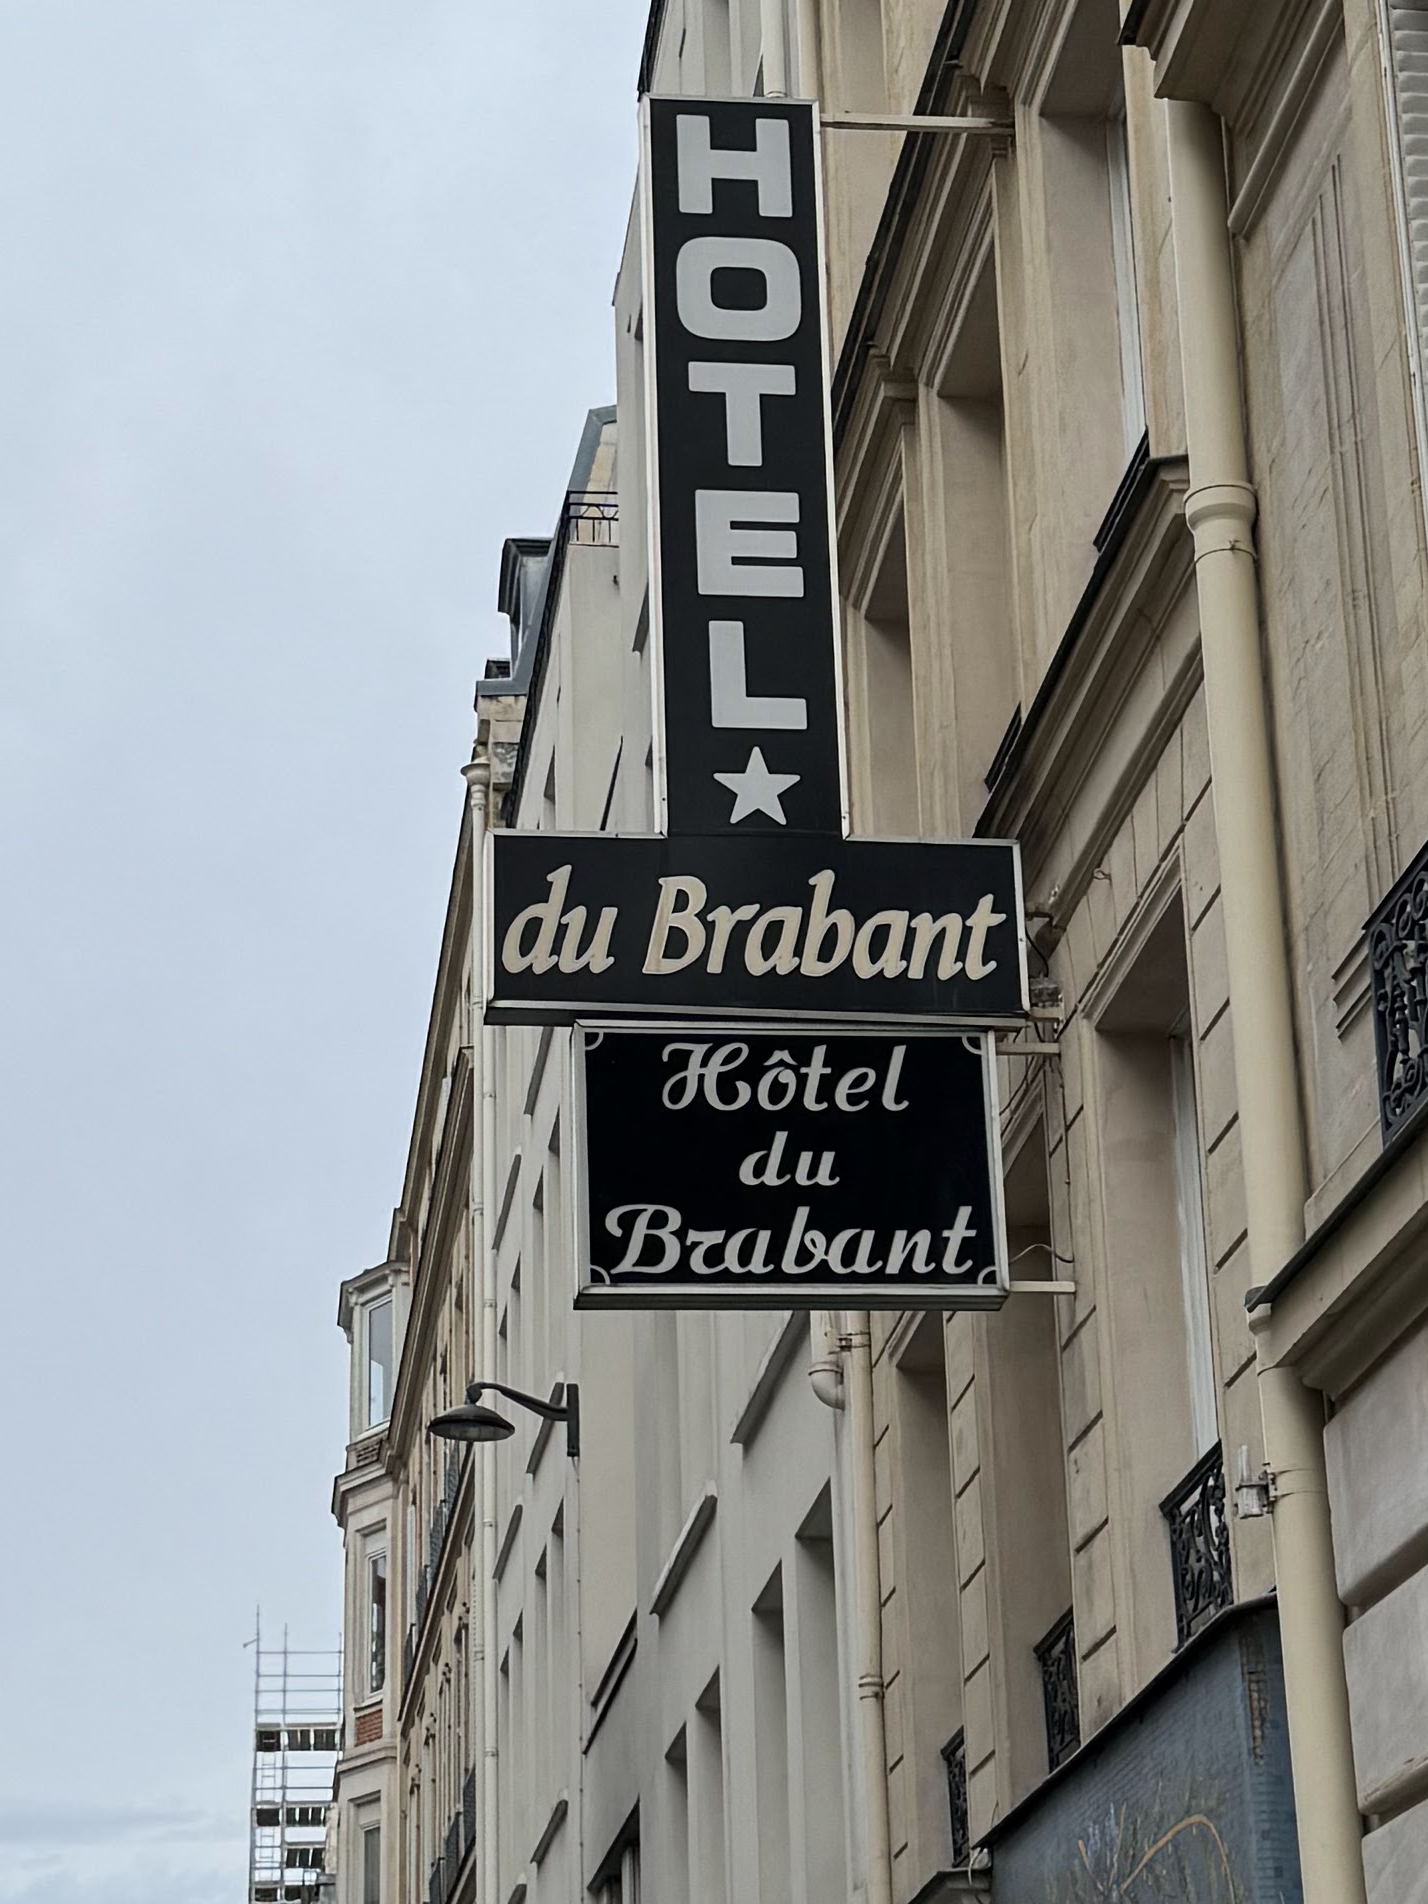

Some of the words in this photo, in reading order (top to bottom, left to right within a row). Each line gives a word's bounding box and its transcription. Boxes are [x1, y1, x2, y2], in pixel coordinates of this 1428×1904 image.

[676, 114, 808, 731] HOTEL
[502, 864, 618, 974] du
[641, 869, 1007, 981] Brabant
[661, 1041, 910, 1112] Hôtel
[738, 1130, 840, 1186] du
[604, 1202, 977, 1277] Brabant
